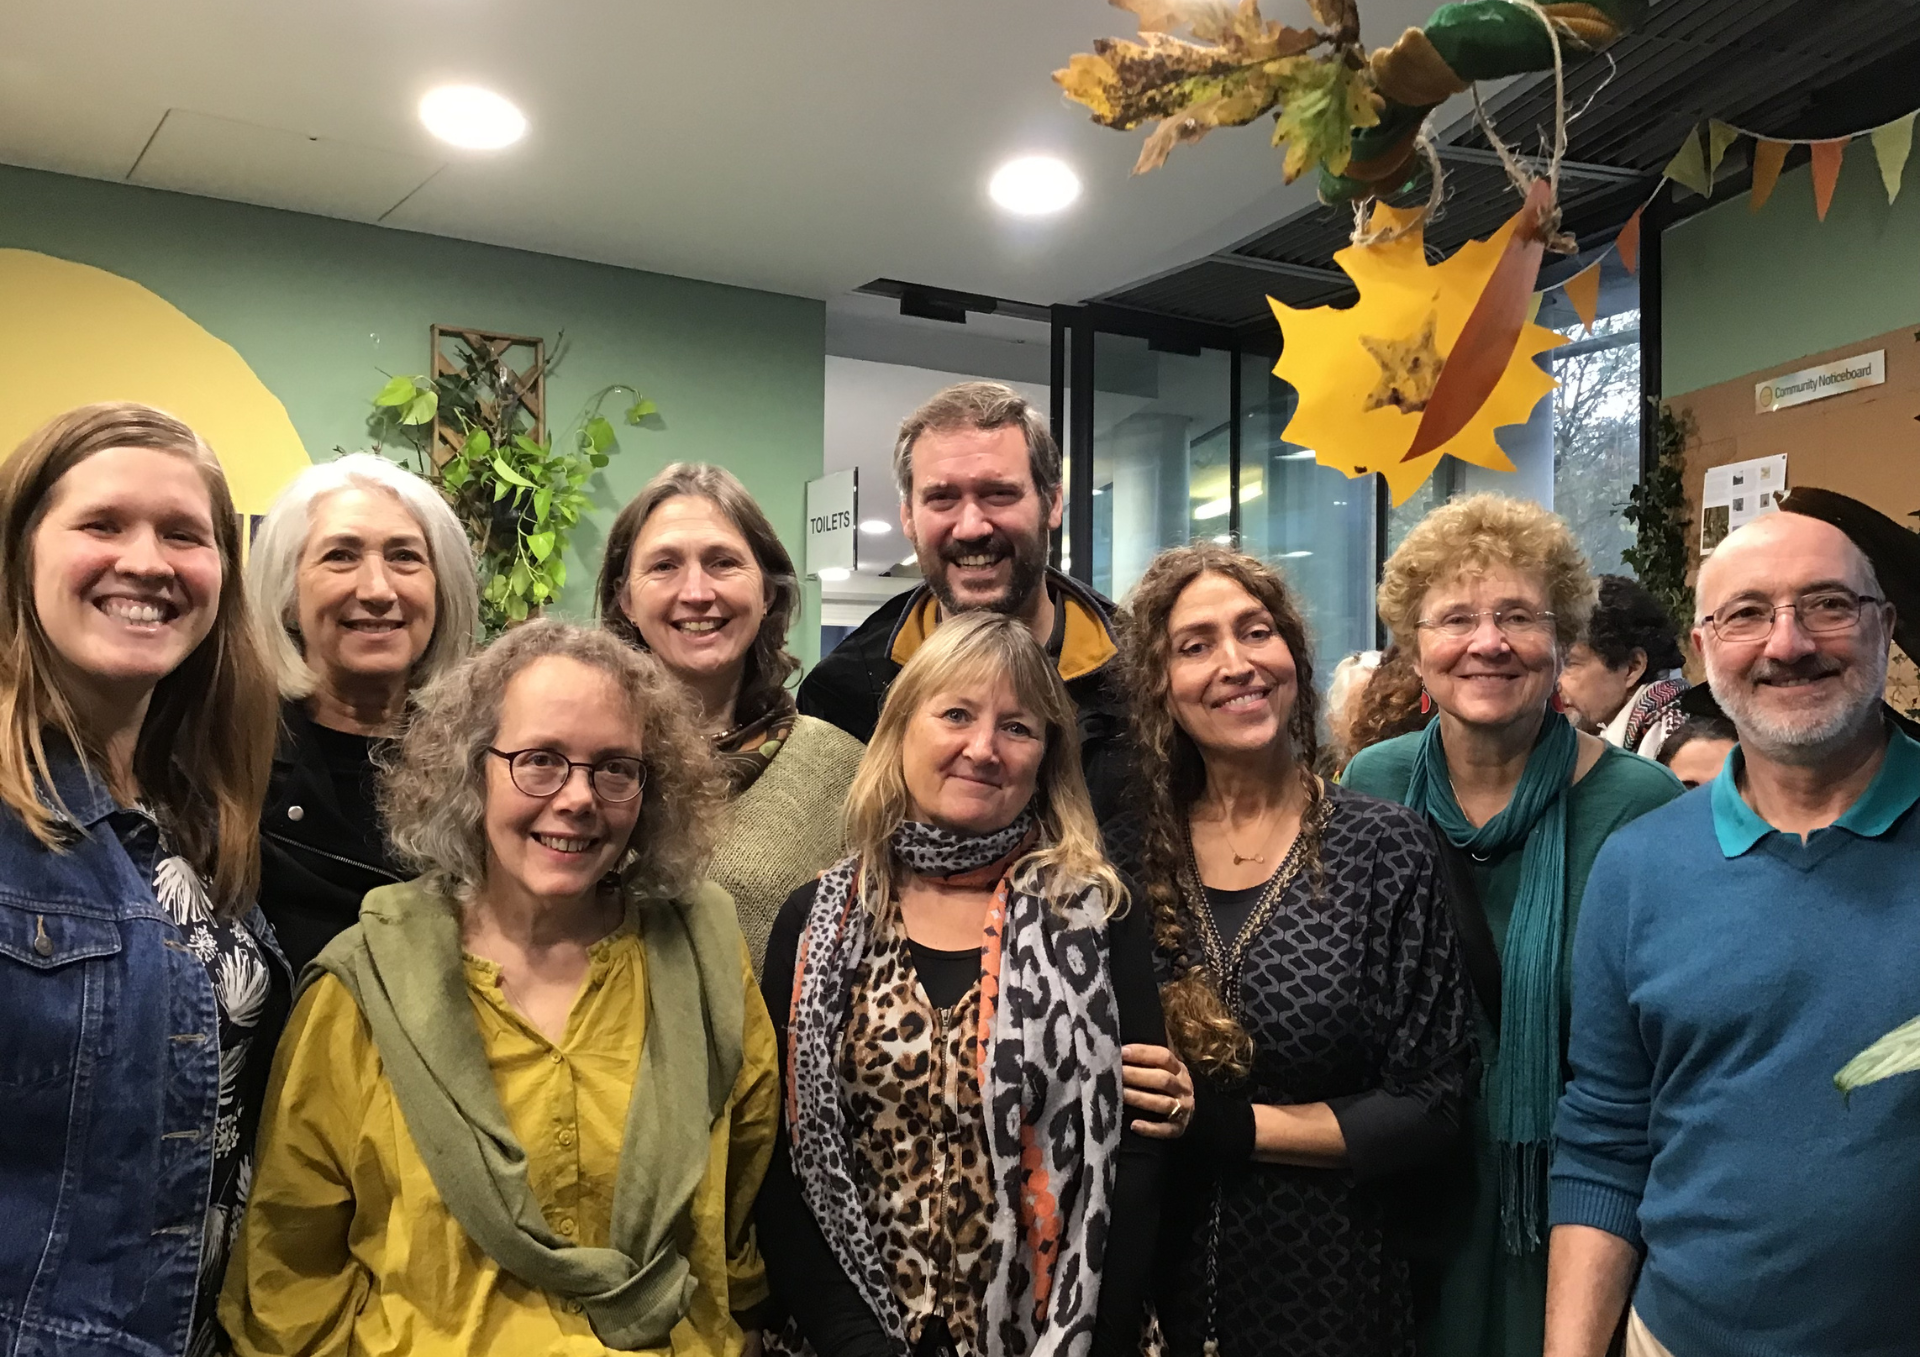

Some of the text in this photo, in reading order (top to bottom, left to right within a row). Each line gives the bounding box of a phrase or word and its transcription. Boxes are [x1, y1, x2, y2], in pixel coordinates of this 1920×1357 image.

[1775, 362, 1872, 399] Community Noticeboard
[810, 510, 850, 535] TOILETS
